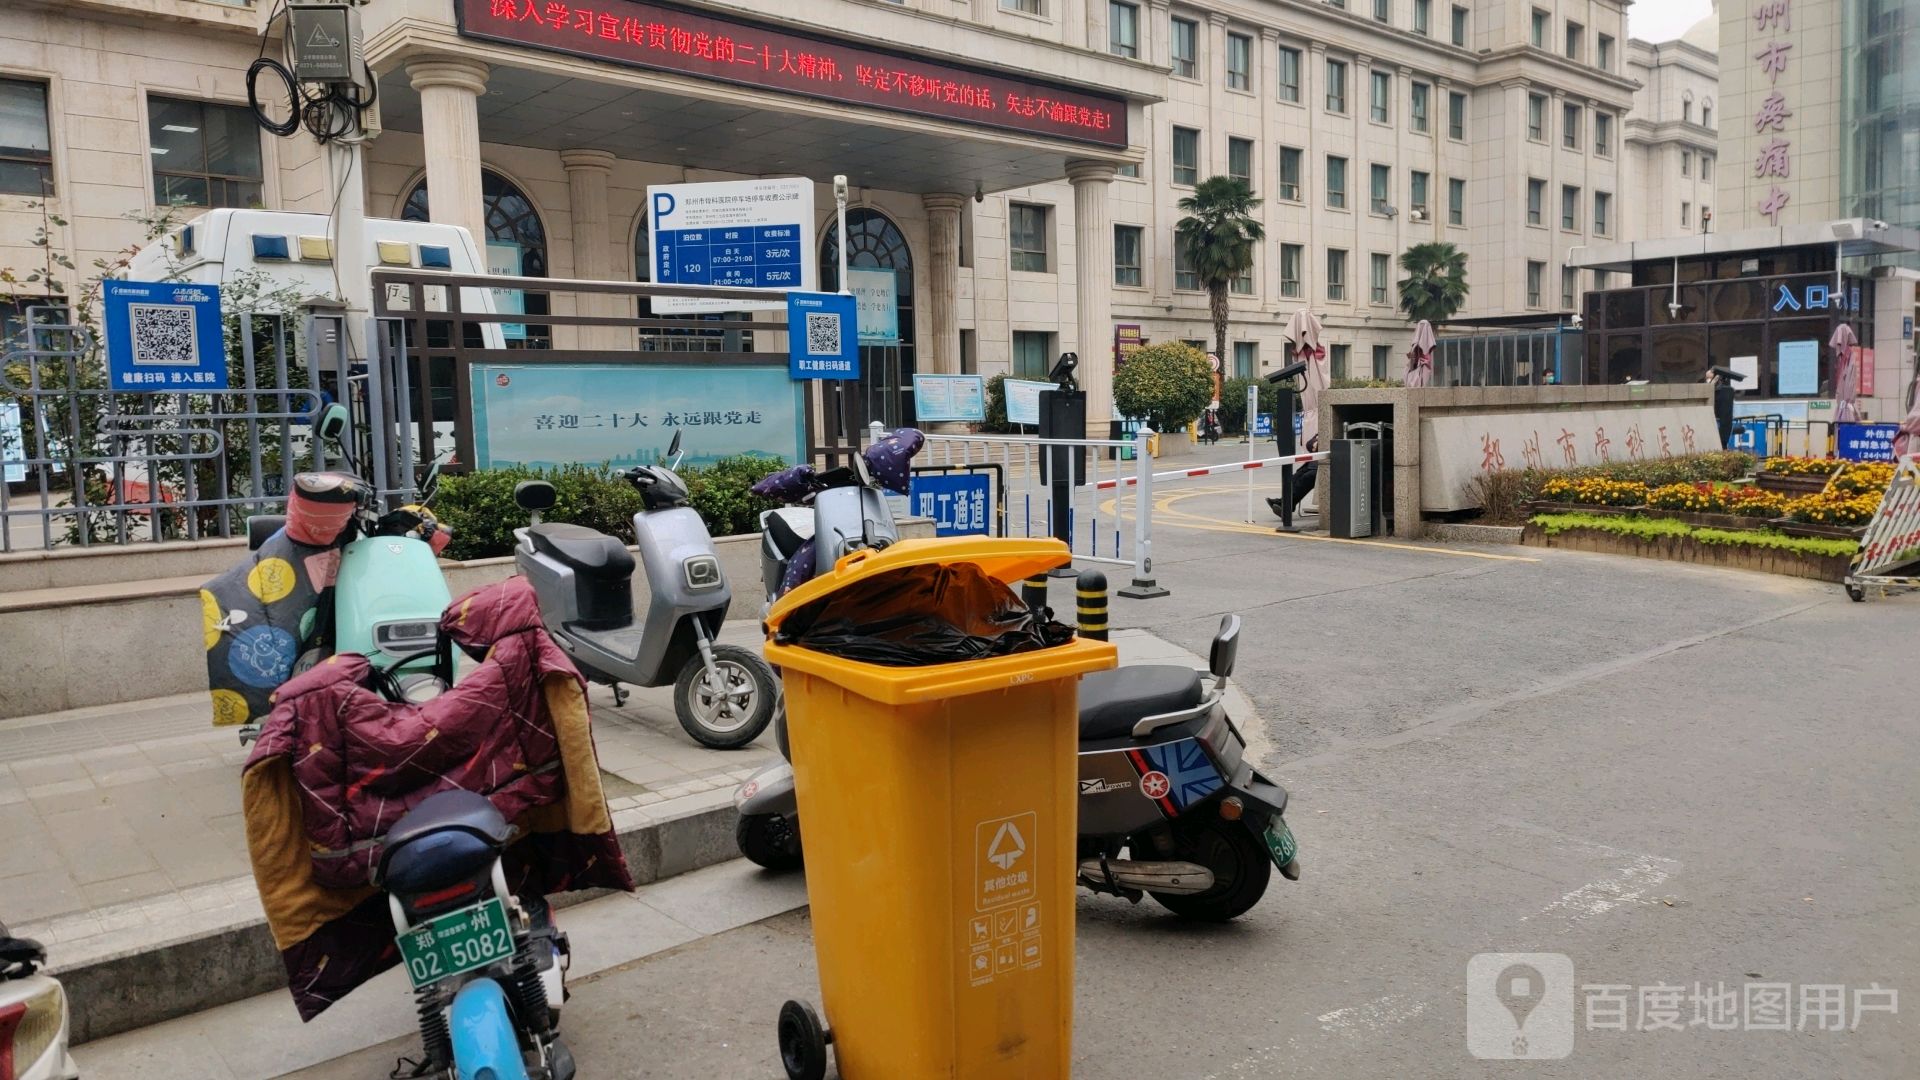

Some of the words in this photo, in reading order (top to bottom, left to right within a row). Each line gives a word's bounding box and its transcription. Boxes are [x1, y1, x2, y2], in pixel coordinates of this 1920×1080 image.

[653, 193, 676, 230] P
[765, 249, 791, 258] 3元/次
[684, 264, 701, 273] 120
[766, 271, 791, 281] 5元/次
[1773, 284, 1829, 312] 入口
[122, 372, 166, 383] 健康扫码
[171, 372, 216, 382] 进入医院
[533, 413, 648, 430] 喜迎二十大
[661, 411, 762, 427] 永远跟党走
[1850, 440, 1894, 450] 请到急诊
[918, 488, 985, 531] 职工通道
[415, 931, 436, 951] 郑
[471, 911, 491, 932] 州
[411, 951, 443, 980] 02
[450, 928, 509, 967] 5082
